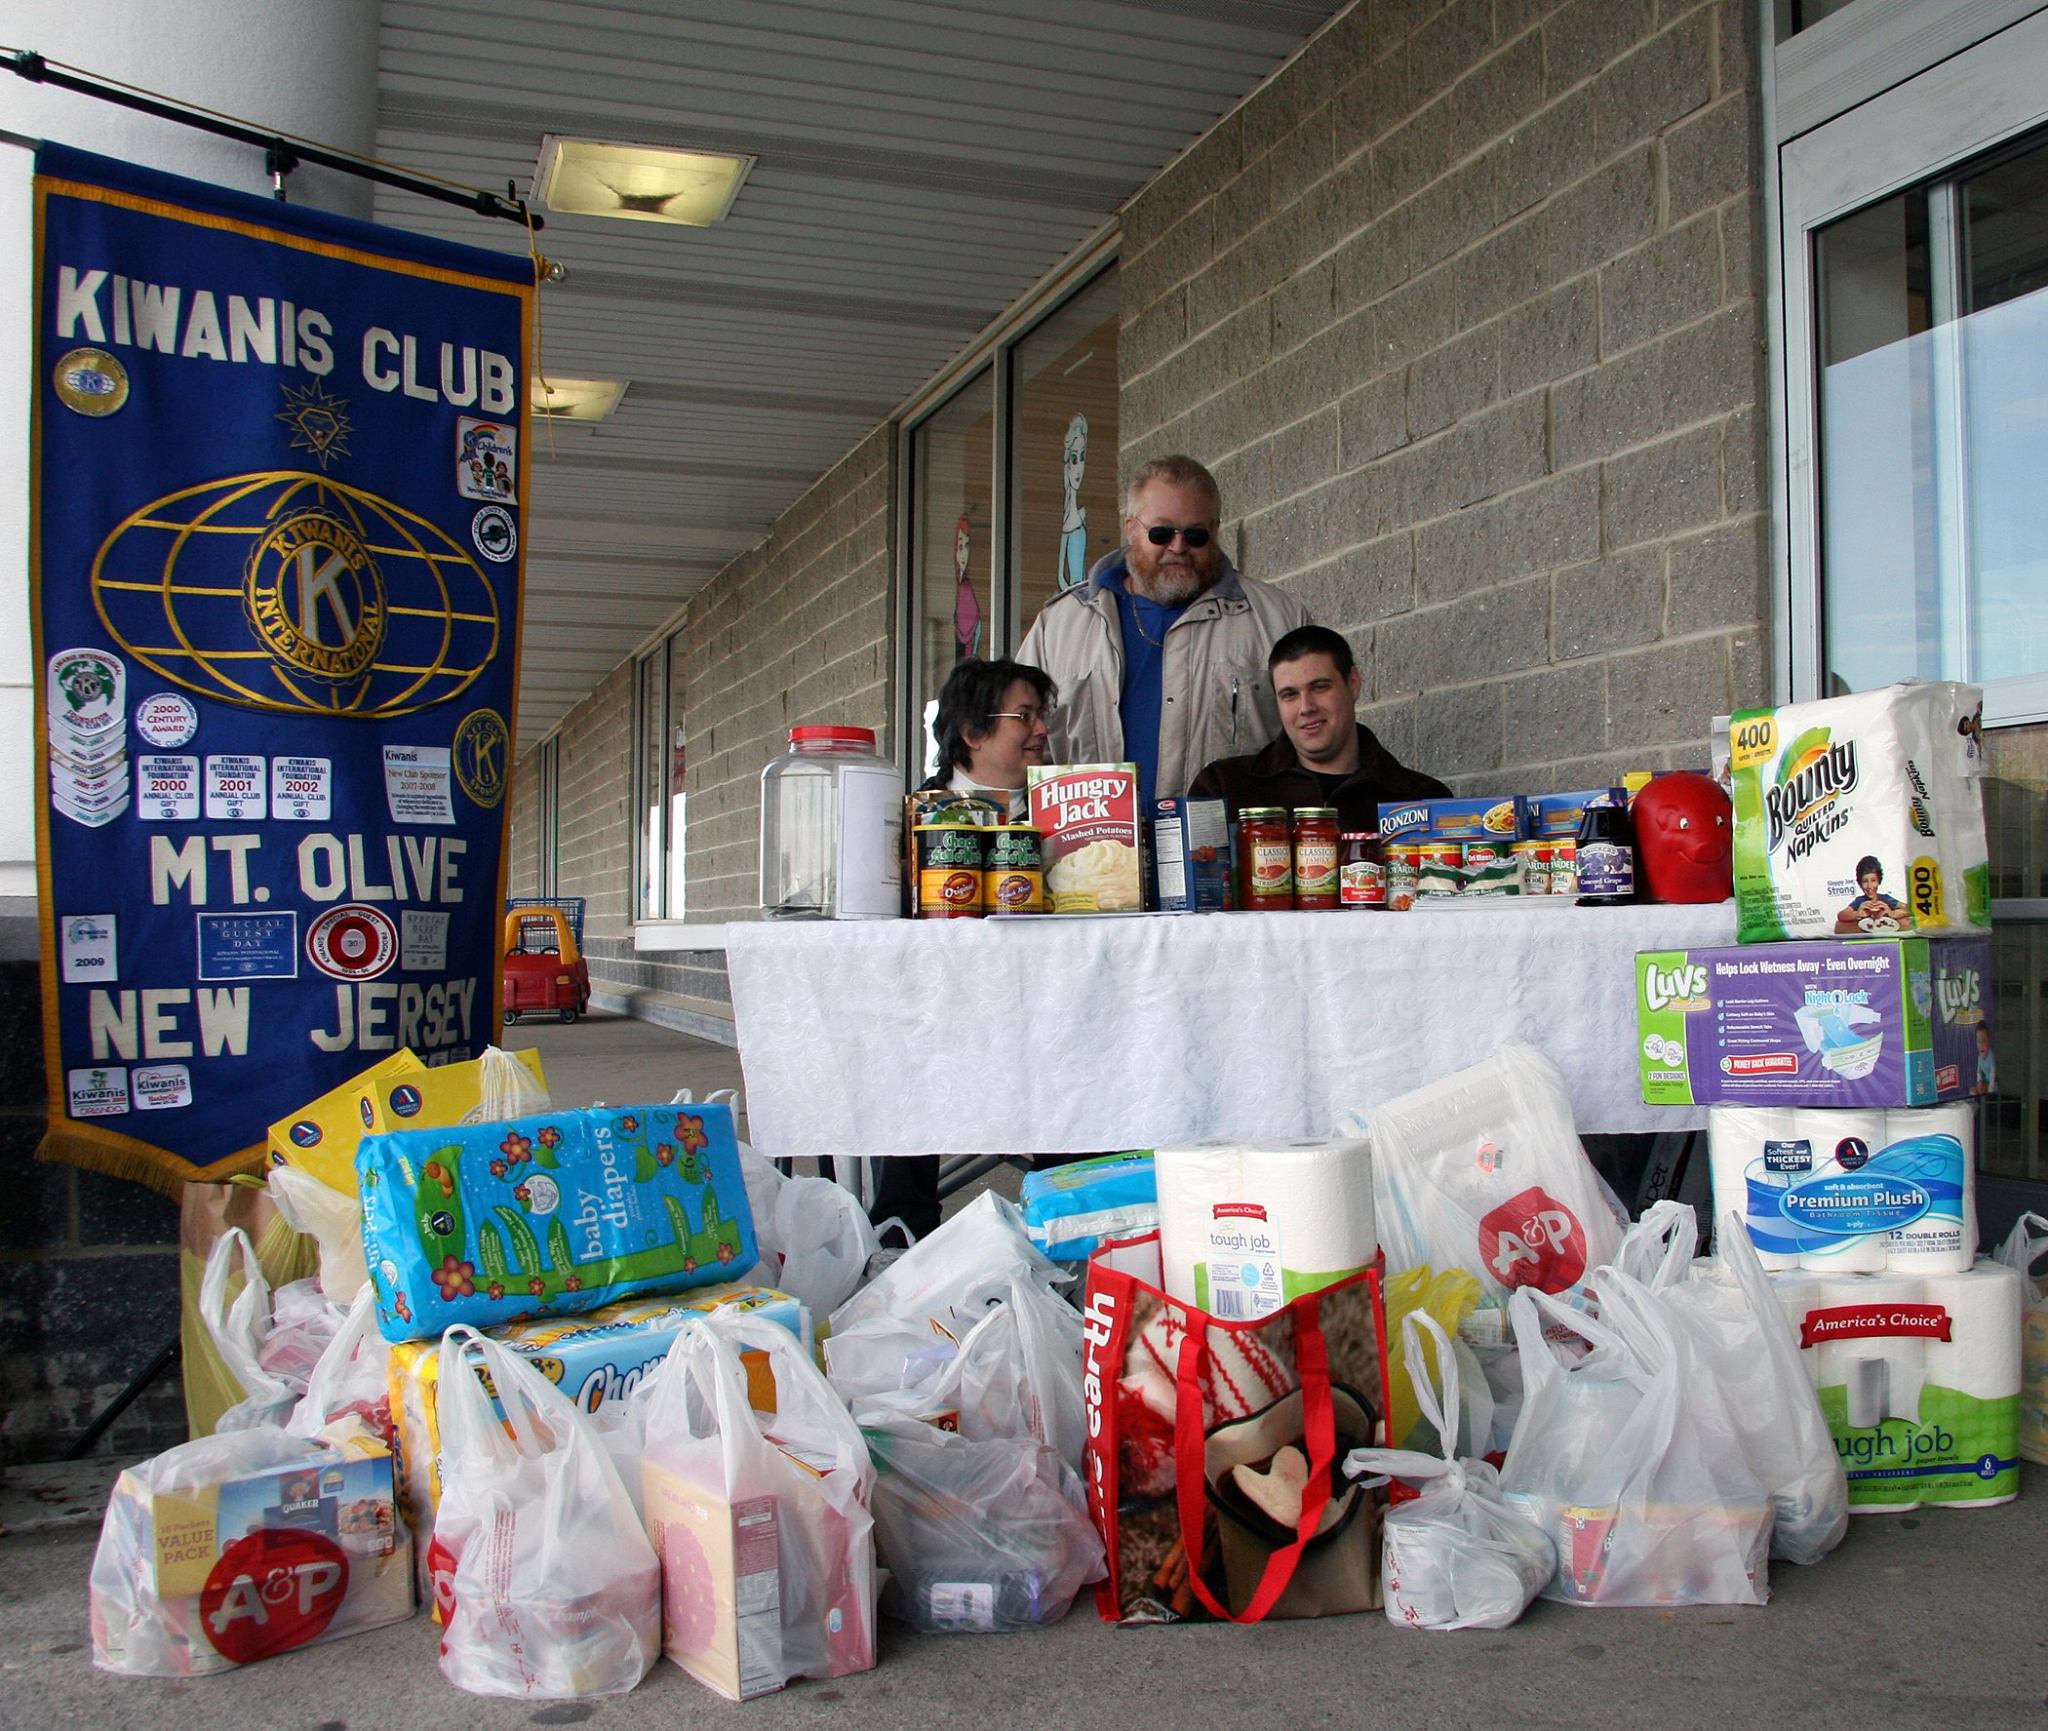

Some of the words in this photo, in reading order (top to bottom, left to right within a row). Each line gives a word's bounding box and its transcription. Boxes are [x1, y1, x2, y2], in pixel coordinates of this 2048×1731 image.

[57, 266, 334, 376] KIWANIS
[363, 327, 515, 415] CLUB
[271, 520, 365, 570] KIWANIS
[297, 546, 358, 643] K
[256, 587, 379, 672] INTERNATIONAL
[153, 705, 181, 713] 2000
[147, 715, 188, 724] CENTURY
[152, 725, 185, 733] AWARD
[1737, 722, 1770, 750] 400
[385, 750, 418, 761] Kiwanis
[142, 764, 194, 772] INTERNATIONAL
[209, 764, 261, 772] INTERNATIONAL
[277, 765, 327, 774] INTERNATIONAL
[281, 773, 322, 781] FOUNDATION
[388, 769, 402, 778] New
[404, 769, 418, 778] Club
[420, 770, 447, 779] Sponsor
[151, 780, 187, 791] 2000
[219, 780, 253, 791] 2001
[285, 781, 319, 792] 2002
[1907, 760, 1930, 800] Napkins
[242, 792, 261, 800] CLUB
[1040, 778, 1127, 810] Hungry
[1766, 739, 1858, 856] Bounty
[160, 800, 178, 808] GIFT
[1053, 799, 1111, 830] Jack
[1380, 809, 1429, 834] RONZONI
[1795, 800, 1836, 836] QUILTED
[1911, 796, 1936, 838] Bounty
[1061, 827, 1094, 843] Mashed
[1096, 827, 1133, 836] Potatoes
[1786, 810, 1850, 870] Napkins
[1298, 847, 1335, 857] CLASSICO
[151, 834, 270, 906] MT.
[297, 833, 468, 903] OLIVE
[944, 880, 975, 898] Original
[1604, 877, 1622, 885] Grape
[1827, 886, 1855, 895] Strong
[1914, 867, 1932, 916] 400
[211, 920, 284, 929] SPECIAL
[322, 911, 350, 931] SPECIAL
[358, 911, 380, 926] GUEST
[222, 929, 273, 938] GUEST
[234, 940, 263, 948] DAY
[317, 936, 330, 964] KIWANIS
[75, 957, 105, 967] 2009
[1715, 962, 1738, 977] Helps
[1740, 961, 1759, 974] Lock
[1760, 961, 1795, 973] Wetness
[1797, 960, 1819, 974] Away
[1826, 958, 1846, 970] Even
[1848, 956, 1890, 973] Overnight
[1805, 990, 1831, 1006] Night
[1845, 990, 1868, 1004] Lock
[89, 987, 250, 1060] NEW
[309, 977, 477, 1052] JERSEY
[1733, 1060, 1750, 1068] MONEY
[1751, 1059, 1764, 1067] BACK
[1764, 1057, 1793, 1067] GUARANTEE
[137, 1078, 186, 1090] Kiwanis
[1653, 1072, 1663, 1080] FUN
[1663, 1072, 1685, 1080] DESIGNS
[72, 1088, 126, 1100] Kiwanis
[594, 1127, 628, 1228] diapers
[1787, 1193, 1868, 1208] Premium
[1873, 1190, 1923, 1206] Plush
[421, 1212, 431, 1234] baby
[1809, 1210, 1860, 1218] Bathroom
[574, 1189, 604, 1261] baby
[1210, 1232, 1247, 1250] tough
[1249, 1233, 1271, 1251] job
[1492, 1210, 1572, 1275] A&P
[1889, 1231, 1902, 1239] 12
[1906, 1232, 1937, 1240] DOUBLE
[1938, 1230, 1960, 1238] ROLLS
[1813, 1313, 1886, 1332] America's
[1890, 1313, 1938, 1327] Choice
[1085, 1293, 1115, 1439] earth
[1834, 1428, 1897, 1464] ugh
[1902, 1425, 1953, 1463] job
[1985, 1457, 1992, 1469] 6
[282, 1498, 319, 1514] QUAKER
[159, 1530, 214, 1548] VALUE
[164, 1546, 210, 1564] PACK
[209, 1562, 341, 1634] A&P
